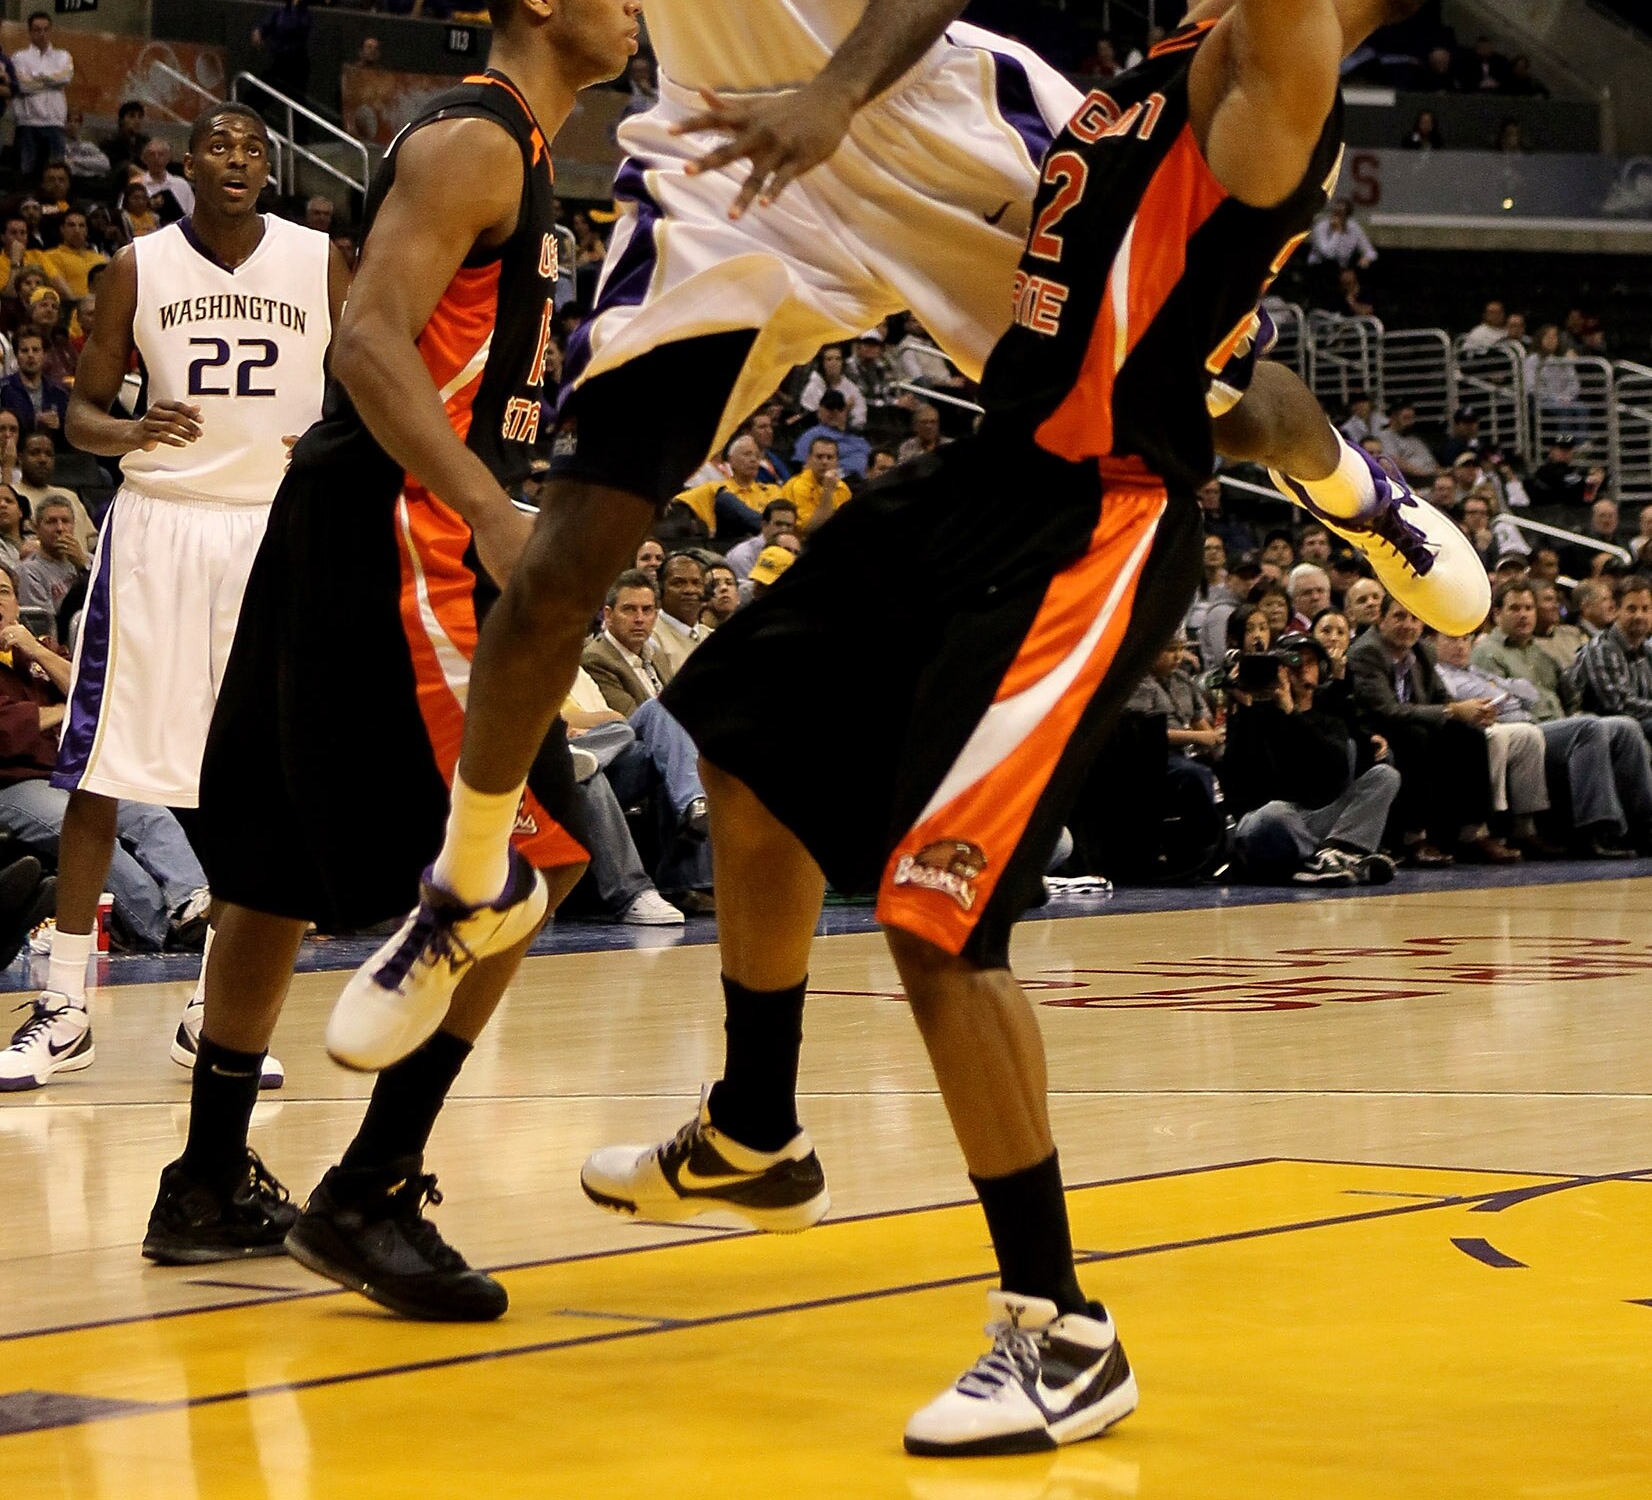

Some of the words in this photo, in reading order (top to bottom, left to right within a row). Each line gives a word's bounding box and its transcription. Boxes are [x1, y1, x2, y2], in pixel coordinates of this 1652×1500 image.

[159, 294, 307, 336] WASHINGTON
[187, 337, 279, 398] 22
[1038, 944, 1652, 1013] APLES
